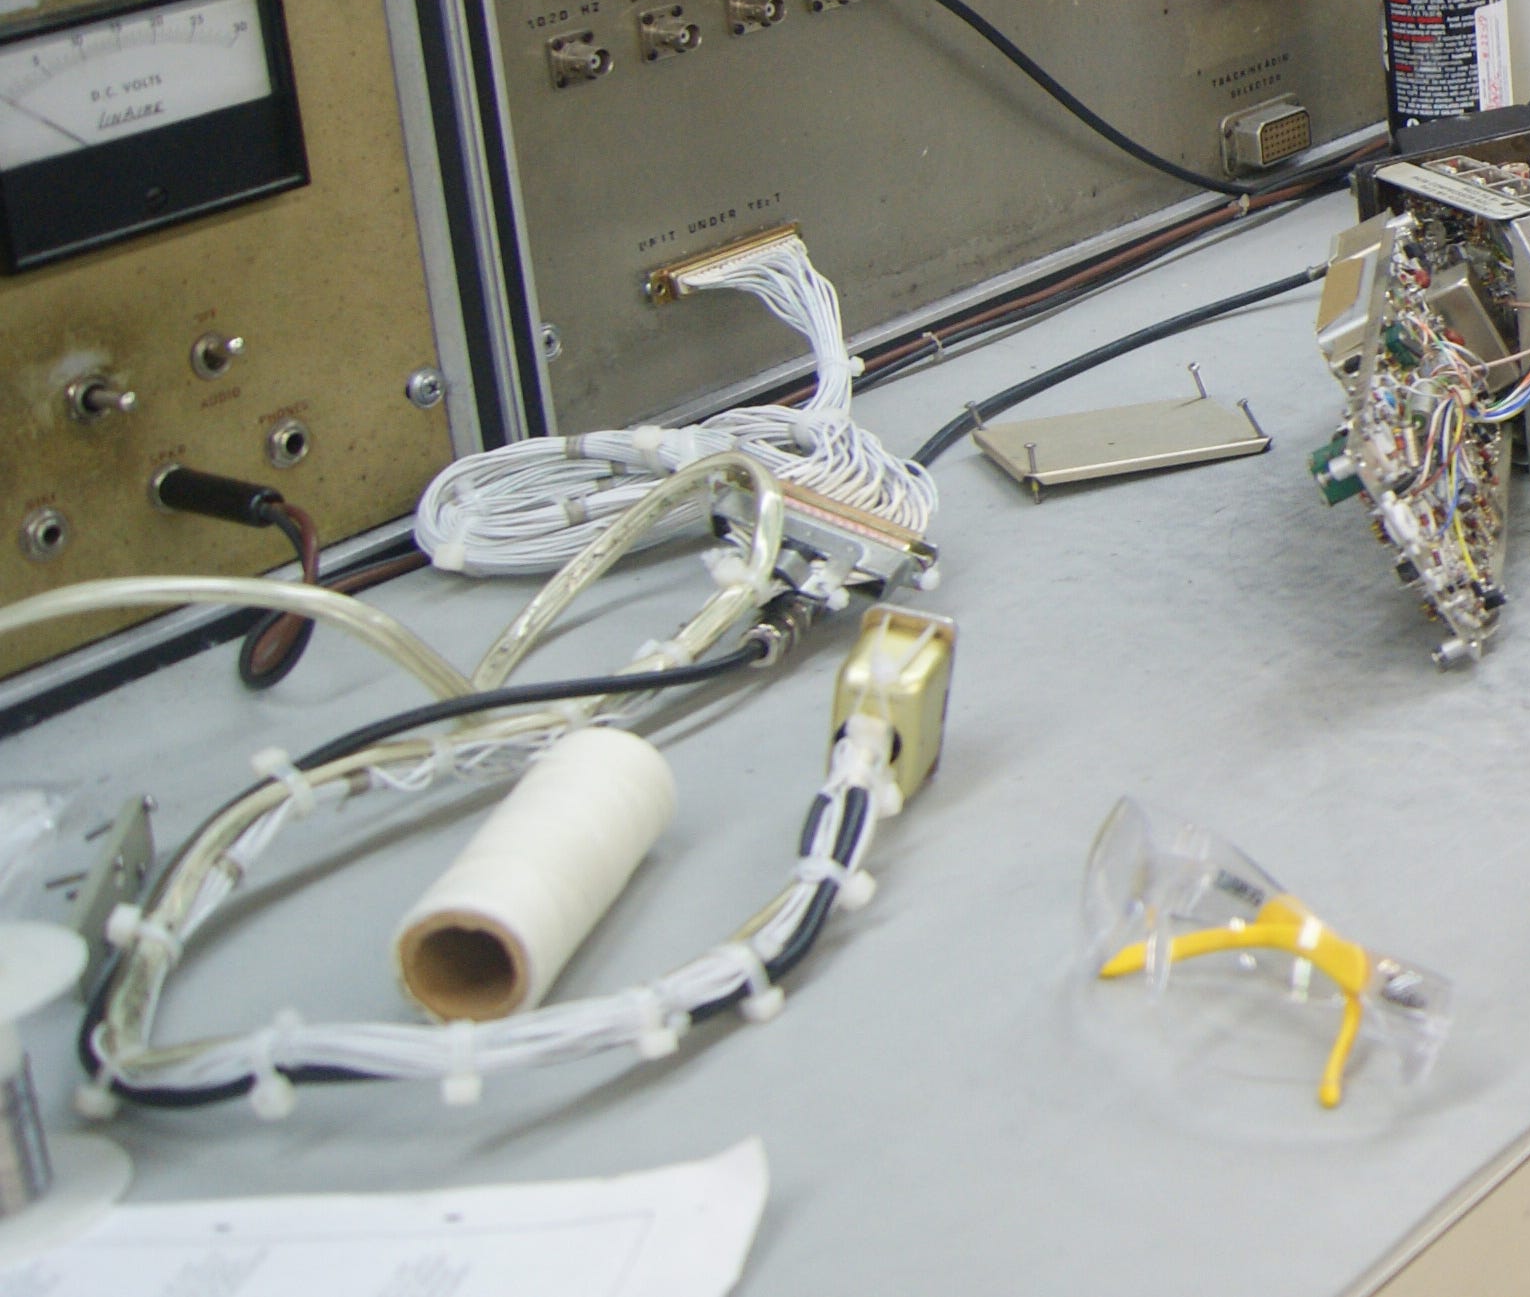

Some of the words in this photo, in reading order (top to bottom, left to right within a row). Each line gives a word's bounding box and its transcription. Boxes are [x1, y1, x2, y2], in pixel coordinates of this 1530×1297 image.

[527, 10, 570, 29] 1020
[580, 1, 601, 15] HZ
[123, 74, 163, 95] VOLTS
[688, 208, 738, 235] UNDER
